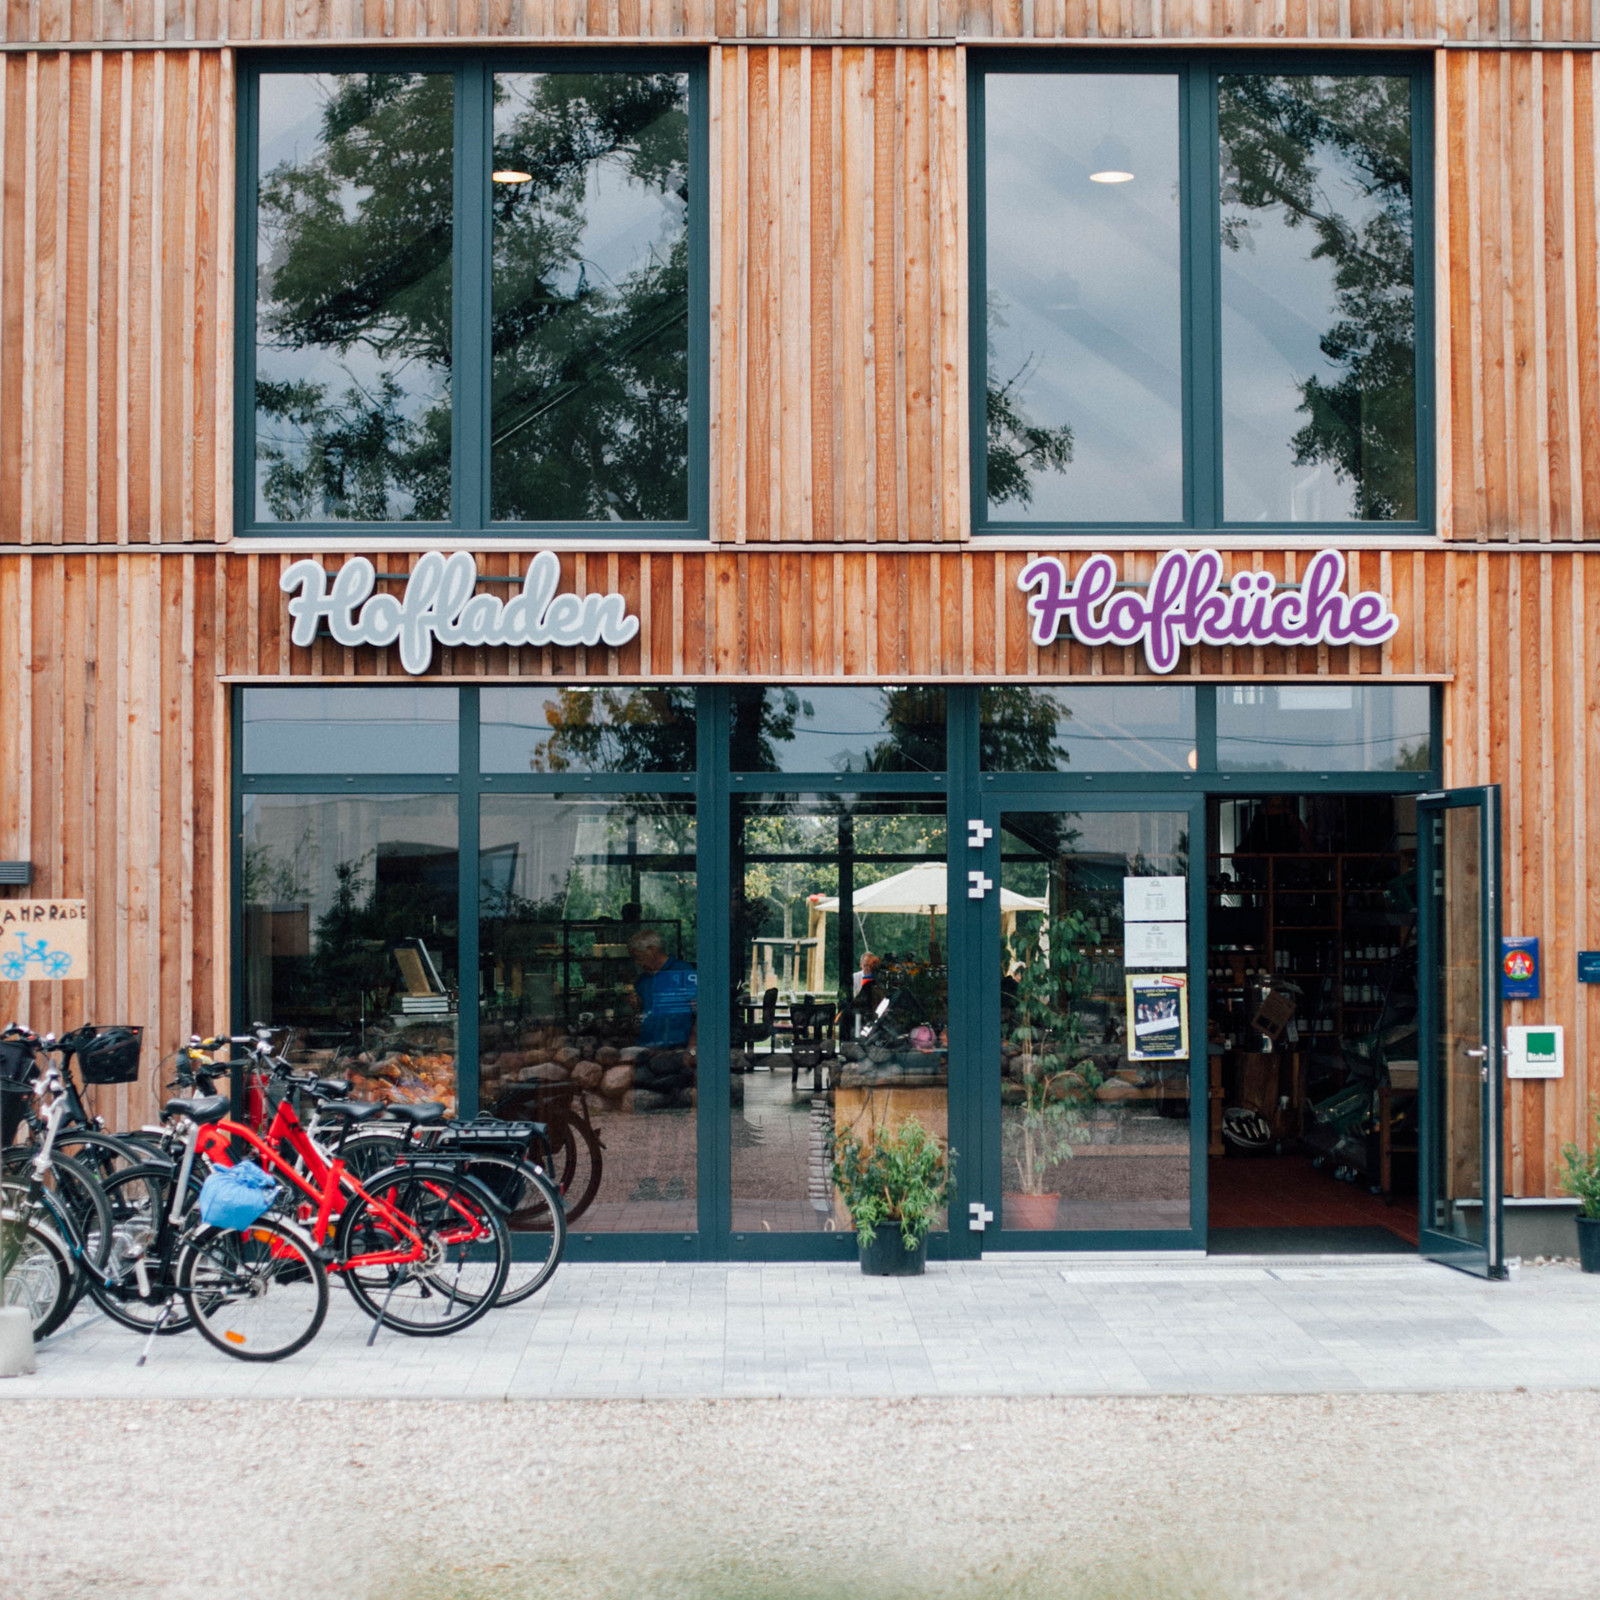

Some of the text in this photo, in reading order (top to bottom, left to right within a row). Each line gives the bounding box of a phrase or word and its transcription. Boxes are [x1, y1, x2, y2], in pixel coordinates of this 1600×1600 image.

[280, 550, 640, 675] Hofladen
[1017, 548, 1399, 674] Hofküche
[0, 904, 87, 924] AHRRÄDE
